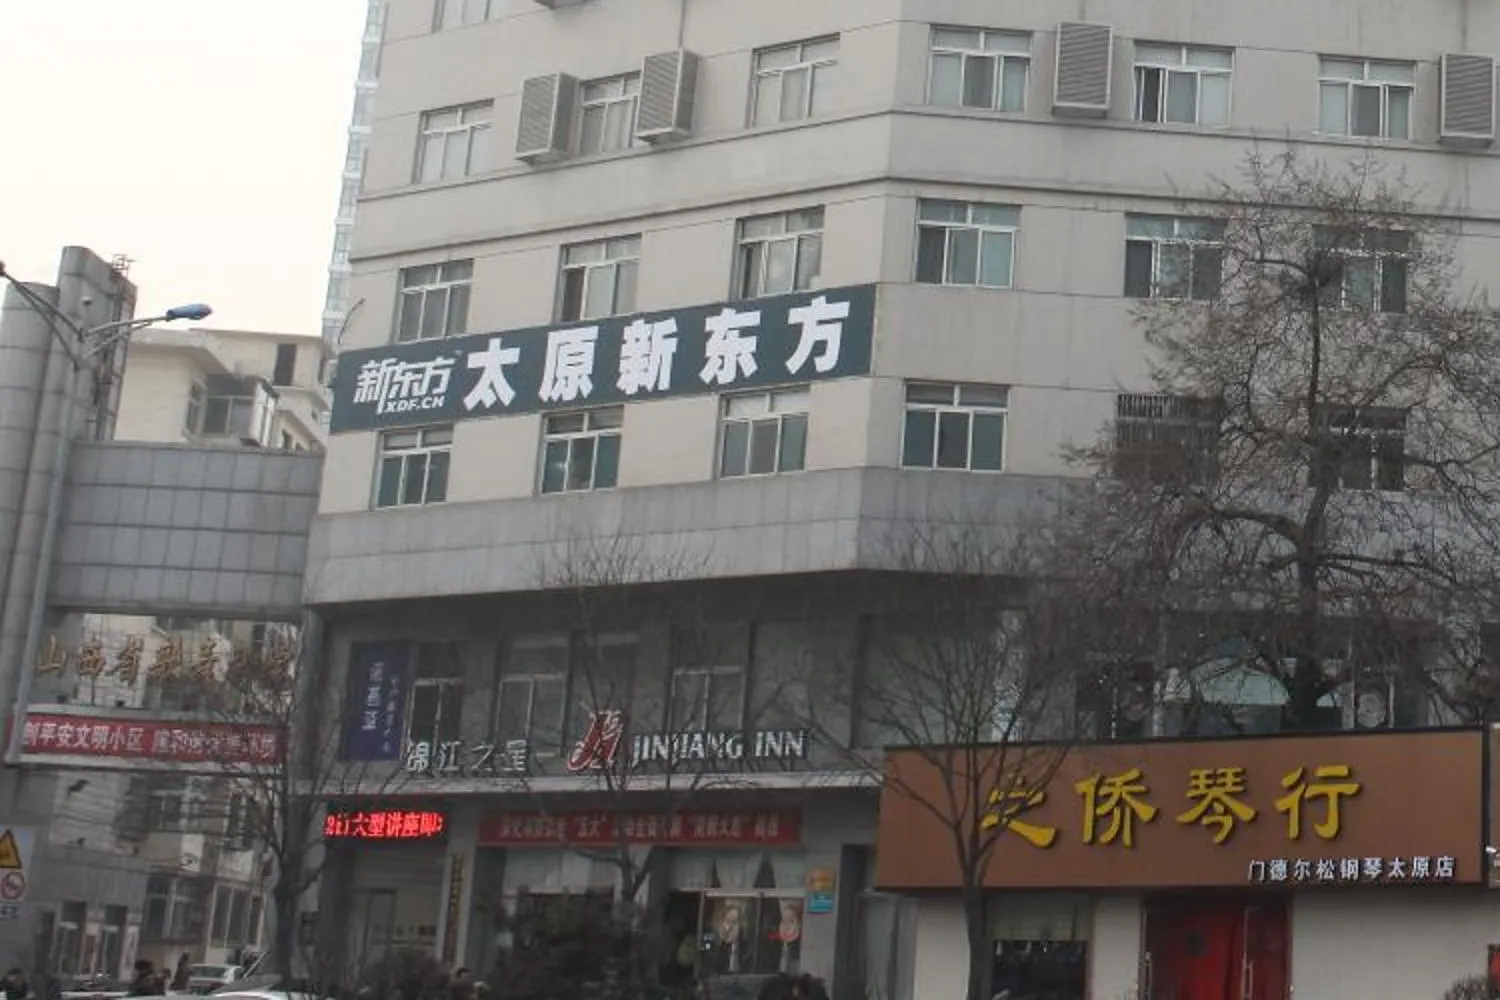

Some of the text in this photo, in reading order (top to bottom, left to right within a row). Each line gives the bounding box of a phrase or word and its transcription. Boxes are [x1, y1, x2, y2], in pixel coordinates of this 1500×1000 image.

[463, 296, 850, 411] 太原新东方
[353, 356, 456, 415] 新东方
[384, 395, 445, 413] XDF.CN
[632, 730, 804, 767] JINJIANG INN
[1248, 856, 1455, 881] 门德尔松钢琴太原店
